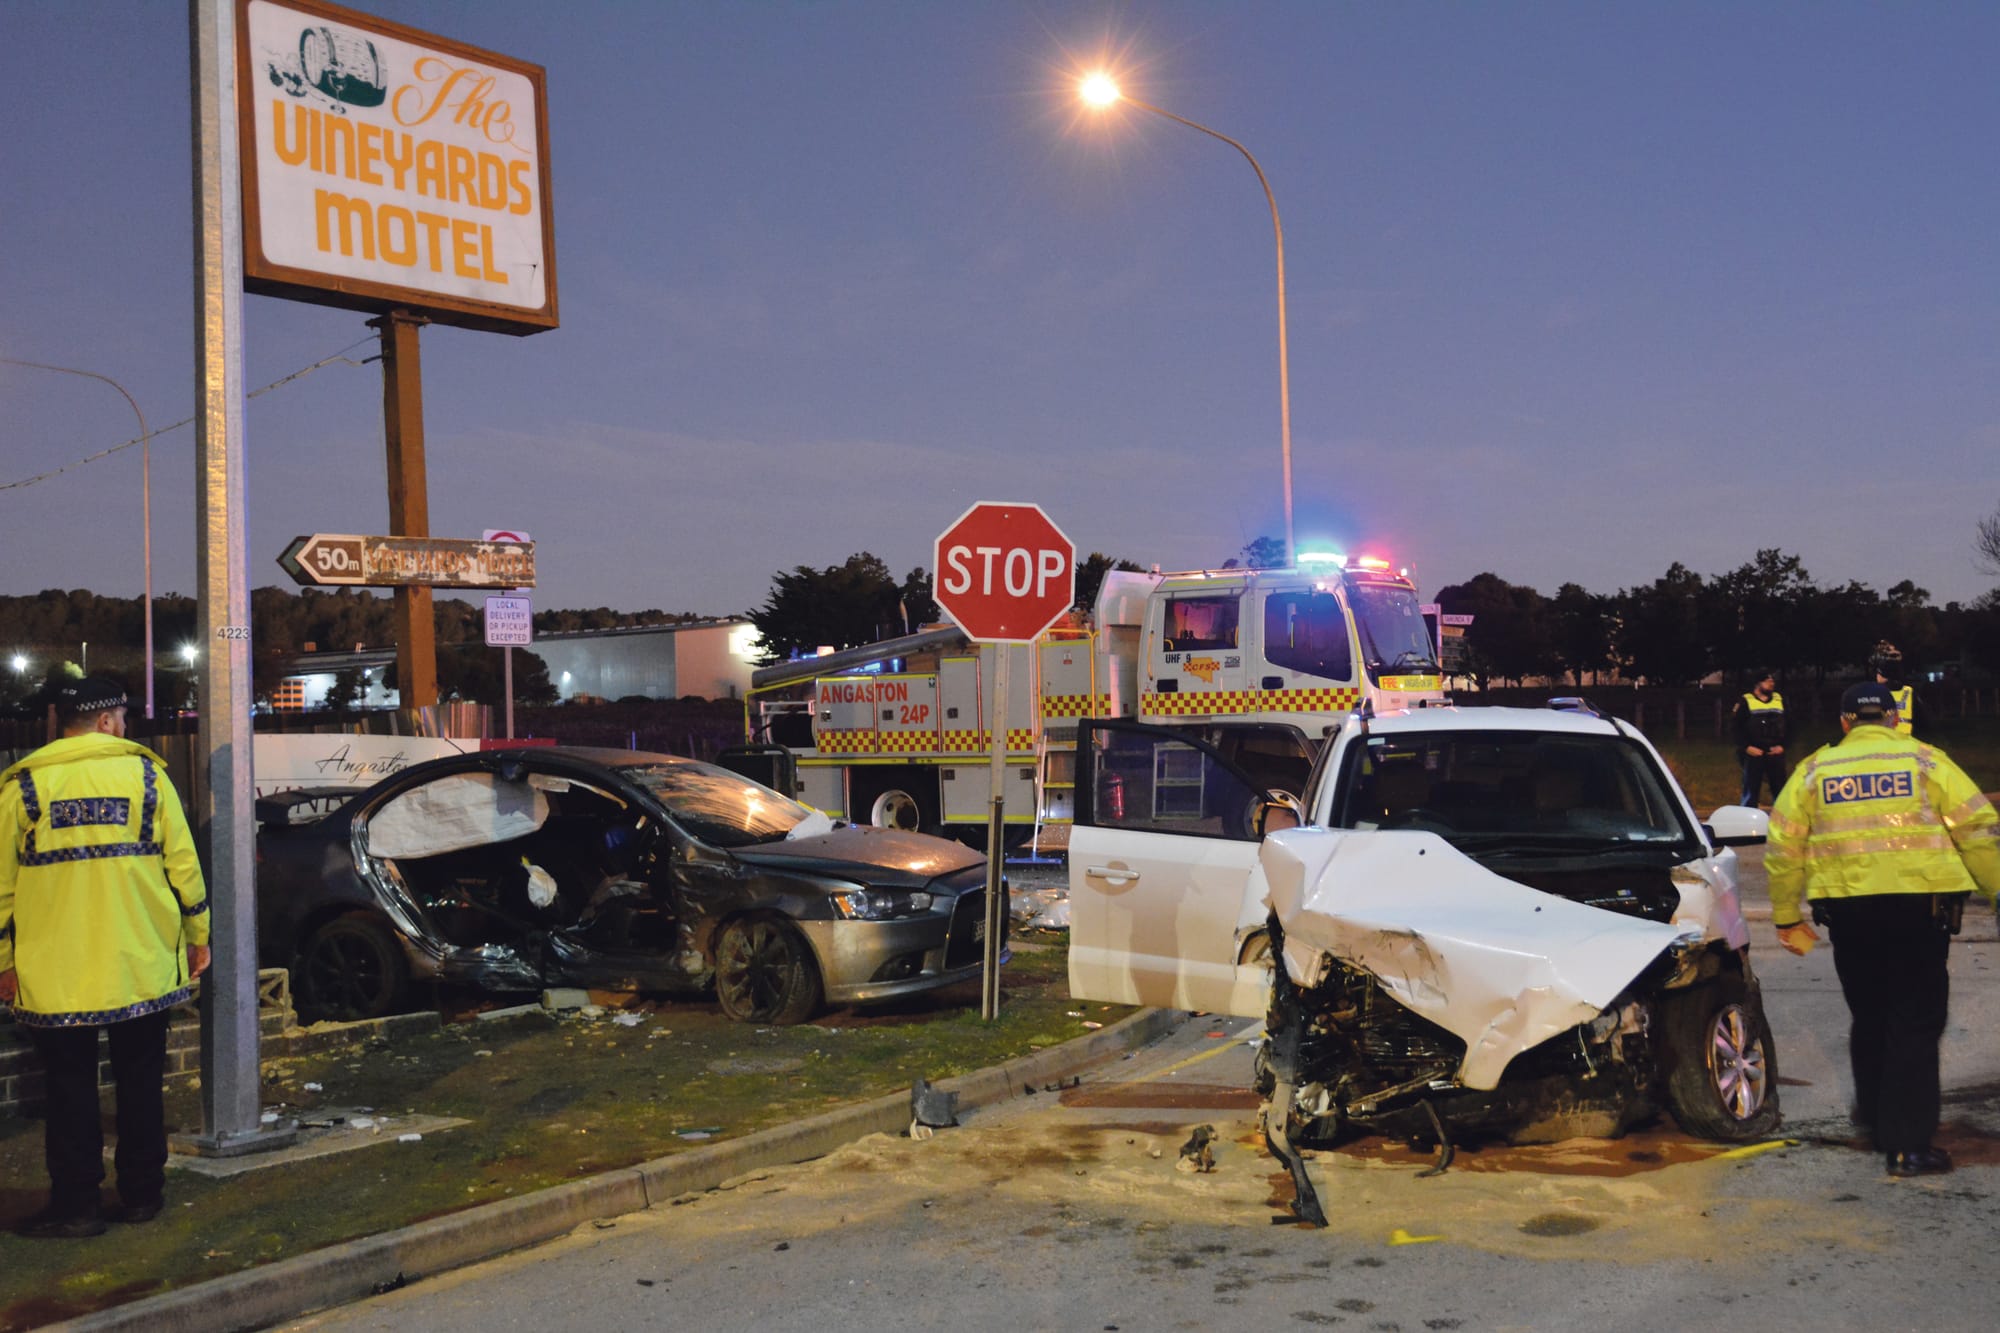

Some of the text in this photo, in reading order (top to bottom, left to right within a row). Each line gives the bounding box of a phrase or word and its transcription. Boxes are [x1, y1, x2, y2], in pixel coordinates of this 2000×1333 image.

[392, 57, 532, 154] The
[273, 101, 532, 216] VINEYARDS
[315, 189, 509, 285] MOTEL
[366, 549, 472, 574] VINEYARDS
[476, 551, 533, 575] MOTEL
[944, 545, 1065, 598] STOP
[490, 611, 526, 620] DELIVERY
[496, 601, 519, 609] LOCAL
[217, 627, 249, 640] 4223
[490, 622, 529, 631] OR PICKUP
[490, 632, 527, 641] EXCEPTED
[1165, 653, 1191, 664] UHF 9
[820, 682, 908, 704] ANGASTON
[900, 704, 930, 725] 24P
[315, 743, 409, 784] Angasto
[1825, 773, 1909, 802] POLICE
[51, 800, 129, 825] POLICE
